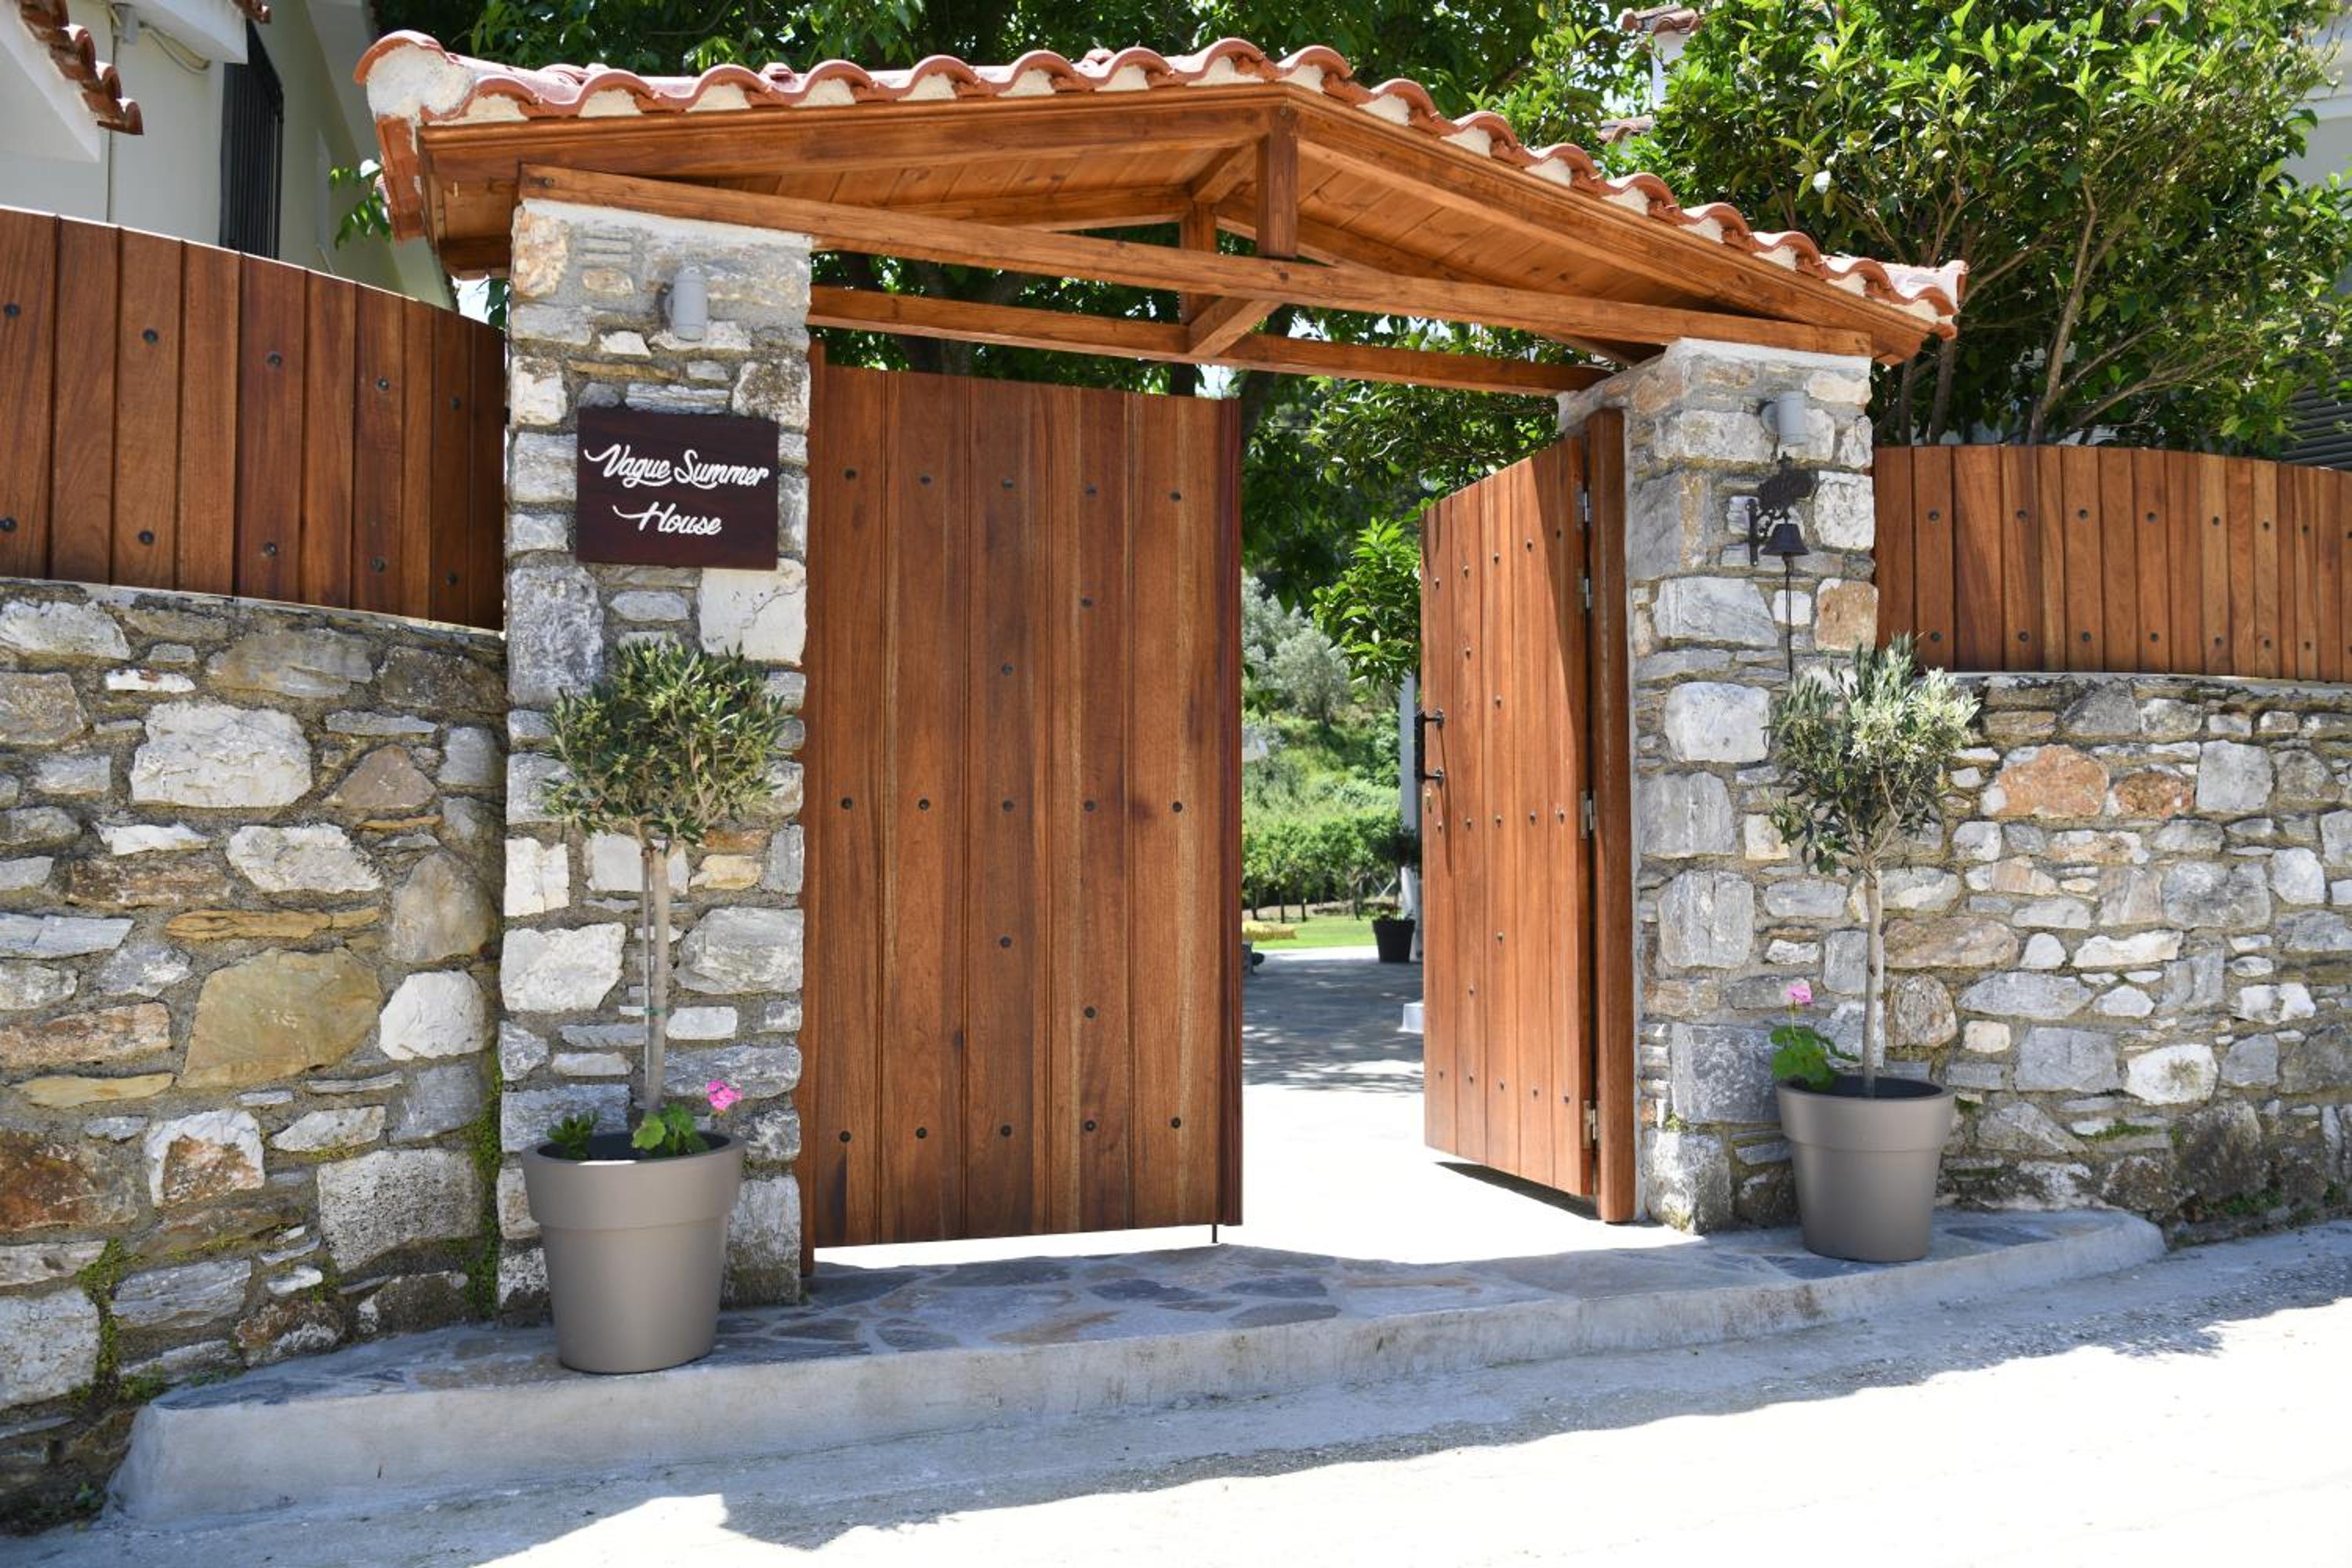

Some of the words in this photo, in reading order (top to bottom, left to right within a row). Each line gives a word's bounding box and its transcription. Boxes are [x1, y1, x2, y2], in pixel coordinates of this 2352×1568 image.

[583, 443, 673, 488] Vague
[673, 448, 770, 490] Summer
[612, 501, 723, 535] House
